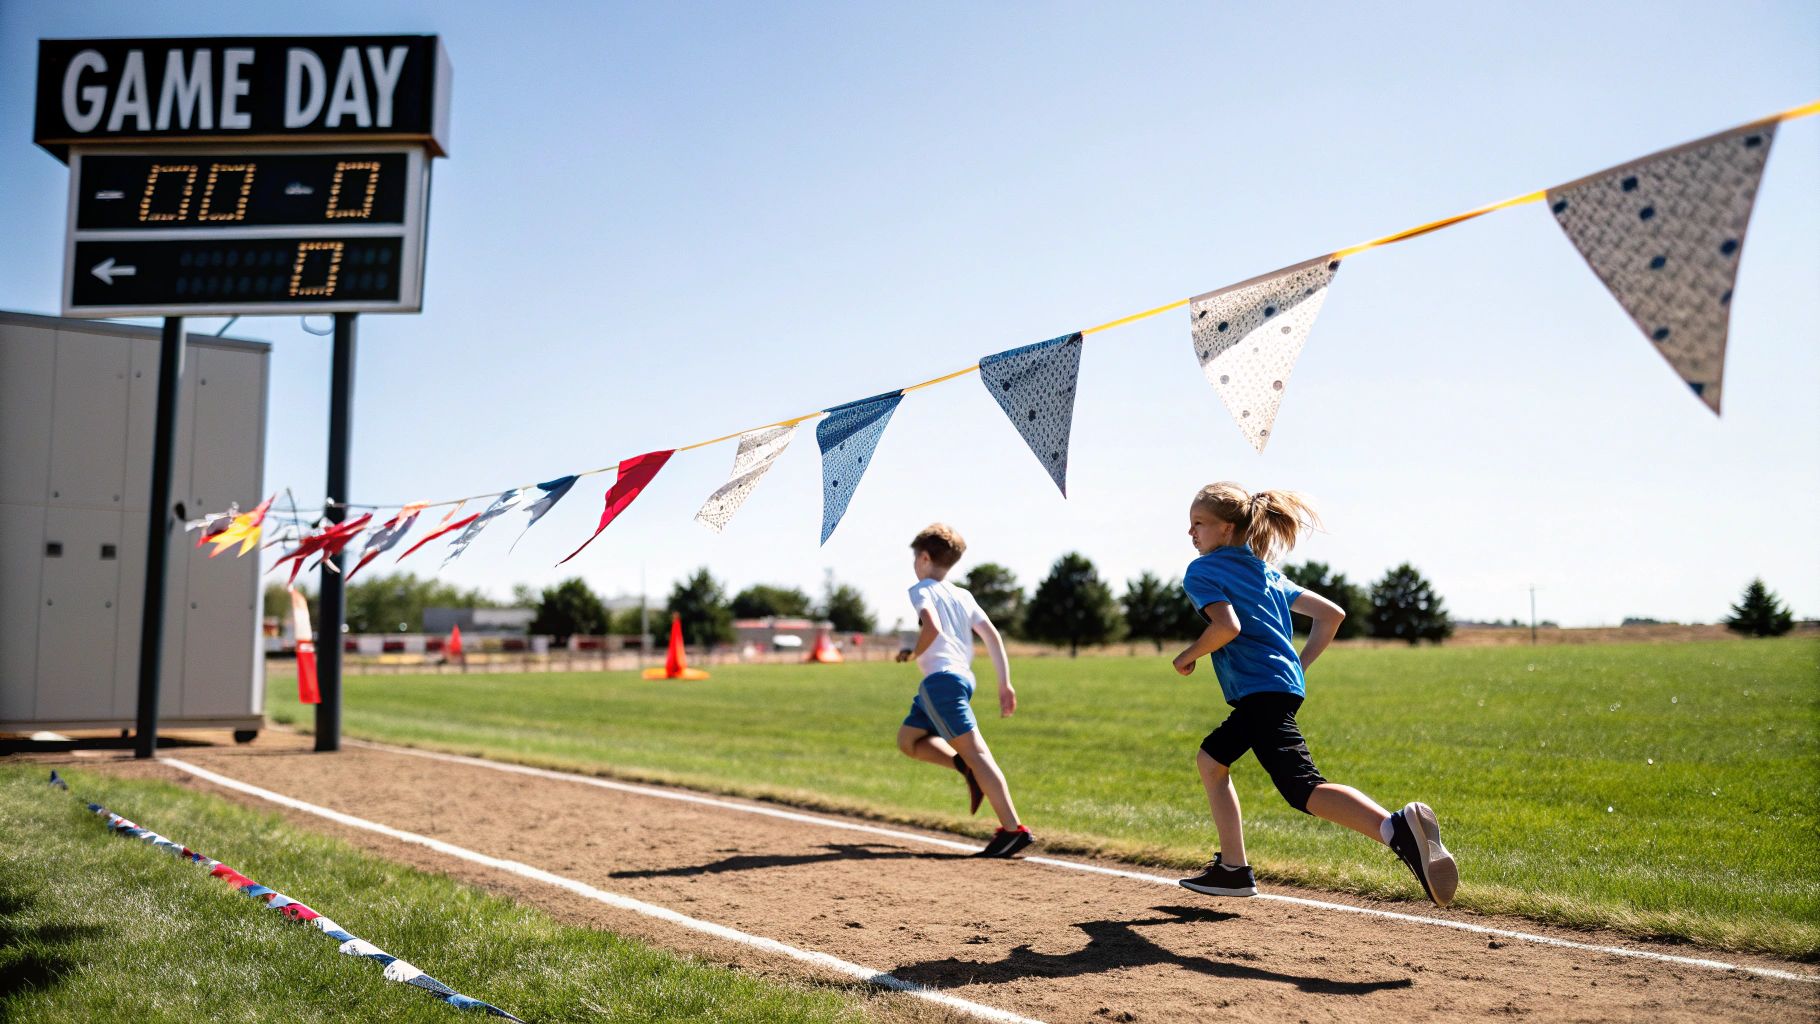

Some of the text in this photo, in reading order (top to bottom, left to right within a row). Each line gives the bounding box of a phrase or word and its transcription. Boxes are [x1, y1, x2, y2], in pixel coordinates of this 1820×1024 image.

[63, 46, 409, 132] GAME DAY
[325, 161, 381, 218] 0
[289, 242, 344, 296] 0
